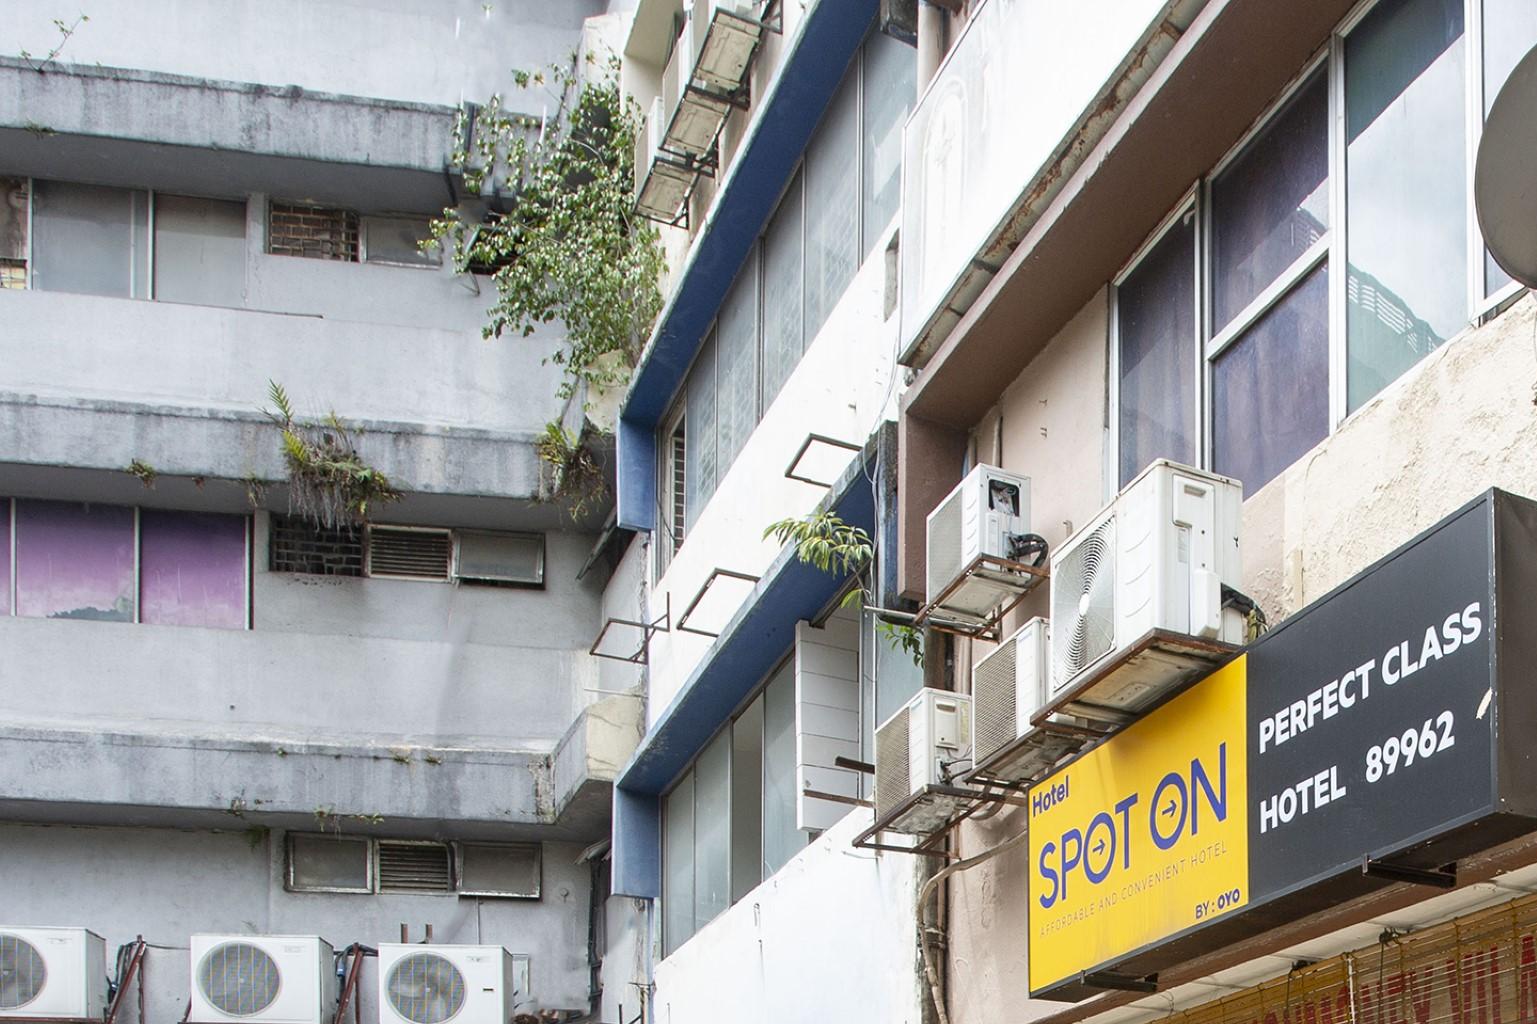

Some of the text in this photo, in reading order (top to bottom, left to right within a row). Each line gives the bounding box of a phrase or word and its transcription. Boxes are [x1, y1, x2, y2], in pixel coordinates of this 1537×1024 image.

[1259, 601, 1483, 754] PERFECT CLASS
[1032, 776, 1069, 817] Hotel
[1039, 742, 1228, 909] SPOT ON
[1259, 709, 1456, 834] HOTEL 89962
[1040, 840, 1228, 938] AFFORDABLE AND CONVENIENT HOTEL
[1195, 900, 1211, 920] BY
[1217, 888, 1241, 910] OYO
